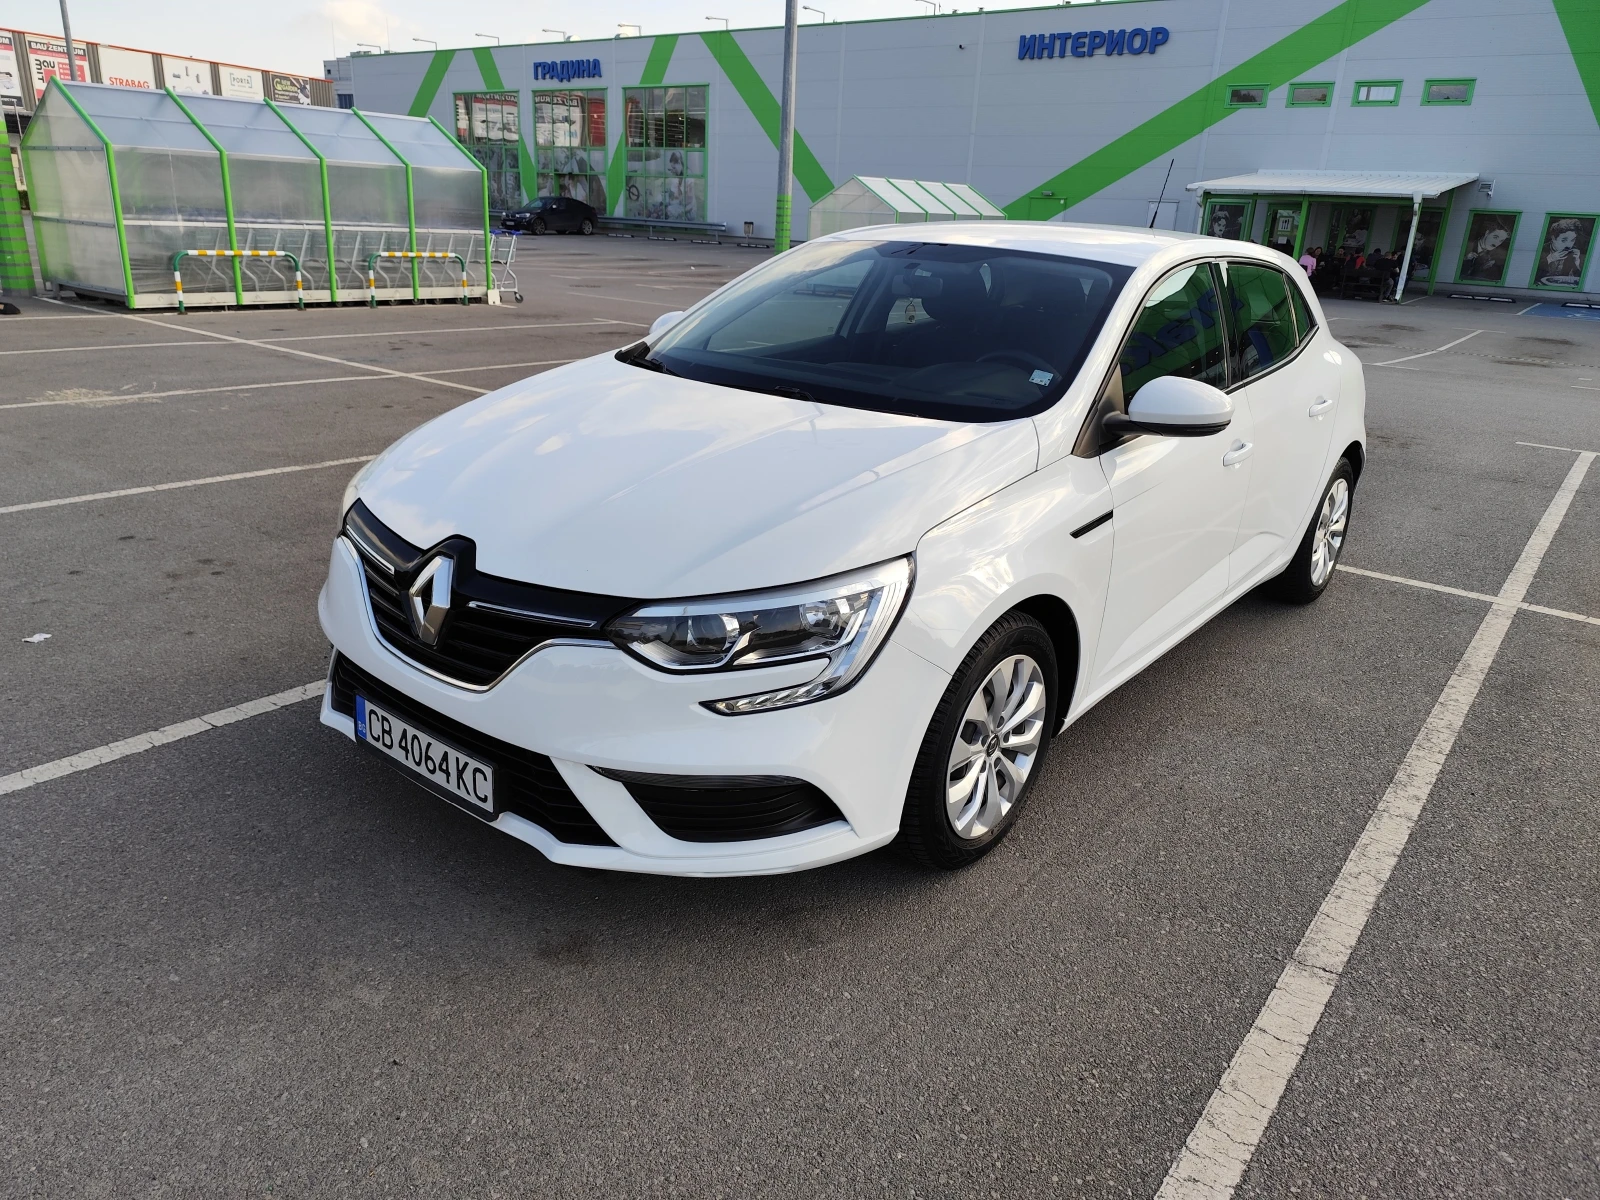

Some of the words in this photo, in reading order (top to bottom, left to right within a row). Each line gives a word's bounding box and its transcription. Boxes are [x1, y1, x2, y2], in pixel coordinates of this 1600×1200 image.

[31, 42, 47, 51] BAU
[48, 45, 84, 55] ZENTUM
[1018, 27, 1170, 60] ИНТЕРИОР
[533, 58, 602, 82] ГРАДИНА
[109, 76, 150, 89] STRABAG
[232, 76, 251, 85] PORTA
[358, 720, 367, 734] BG
[368, 708, 394, 750] CB
[398, 727, 451, 784] 4064
[455, 756, 488, 804] KC
